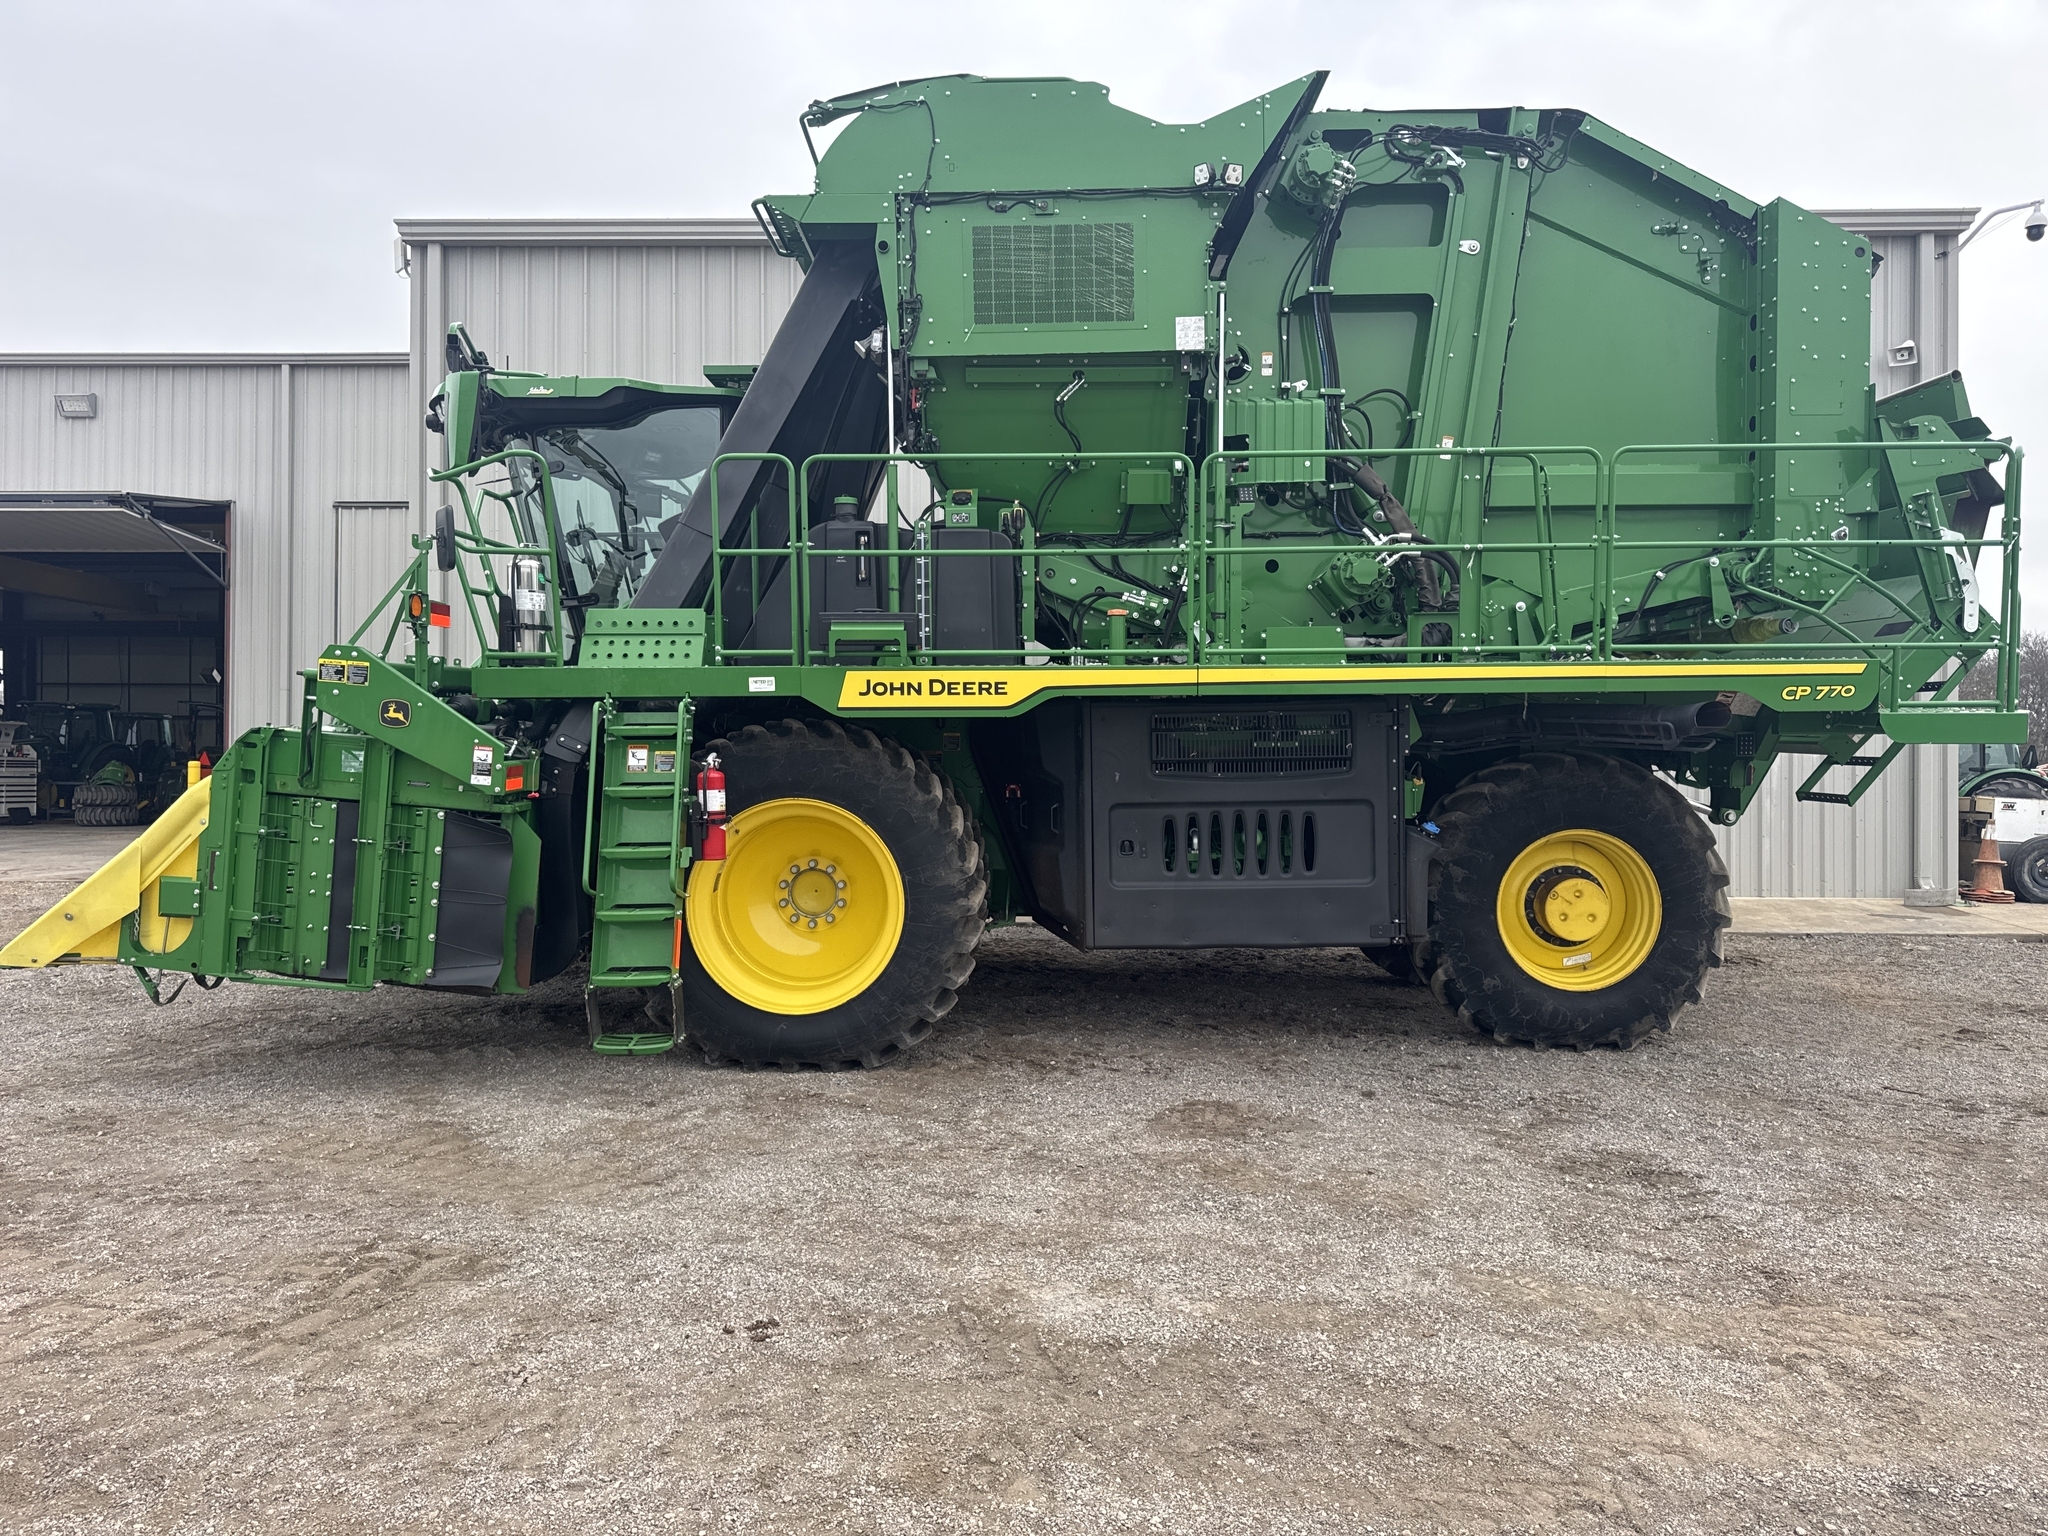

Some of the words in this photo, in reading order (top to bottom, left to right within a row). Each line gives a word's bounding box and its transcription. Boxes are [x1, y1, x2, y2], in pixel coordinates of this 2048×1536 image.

[858, 679, 922, 696] JOHN
[929, 679, 1008, 696] DEERE
[1781, 685, 1812, 701] CP
[1814, 684, 1856, 700] 770
